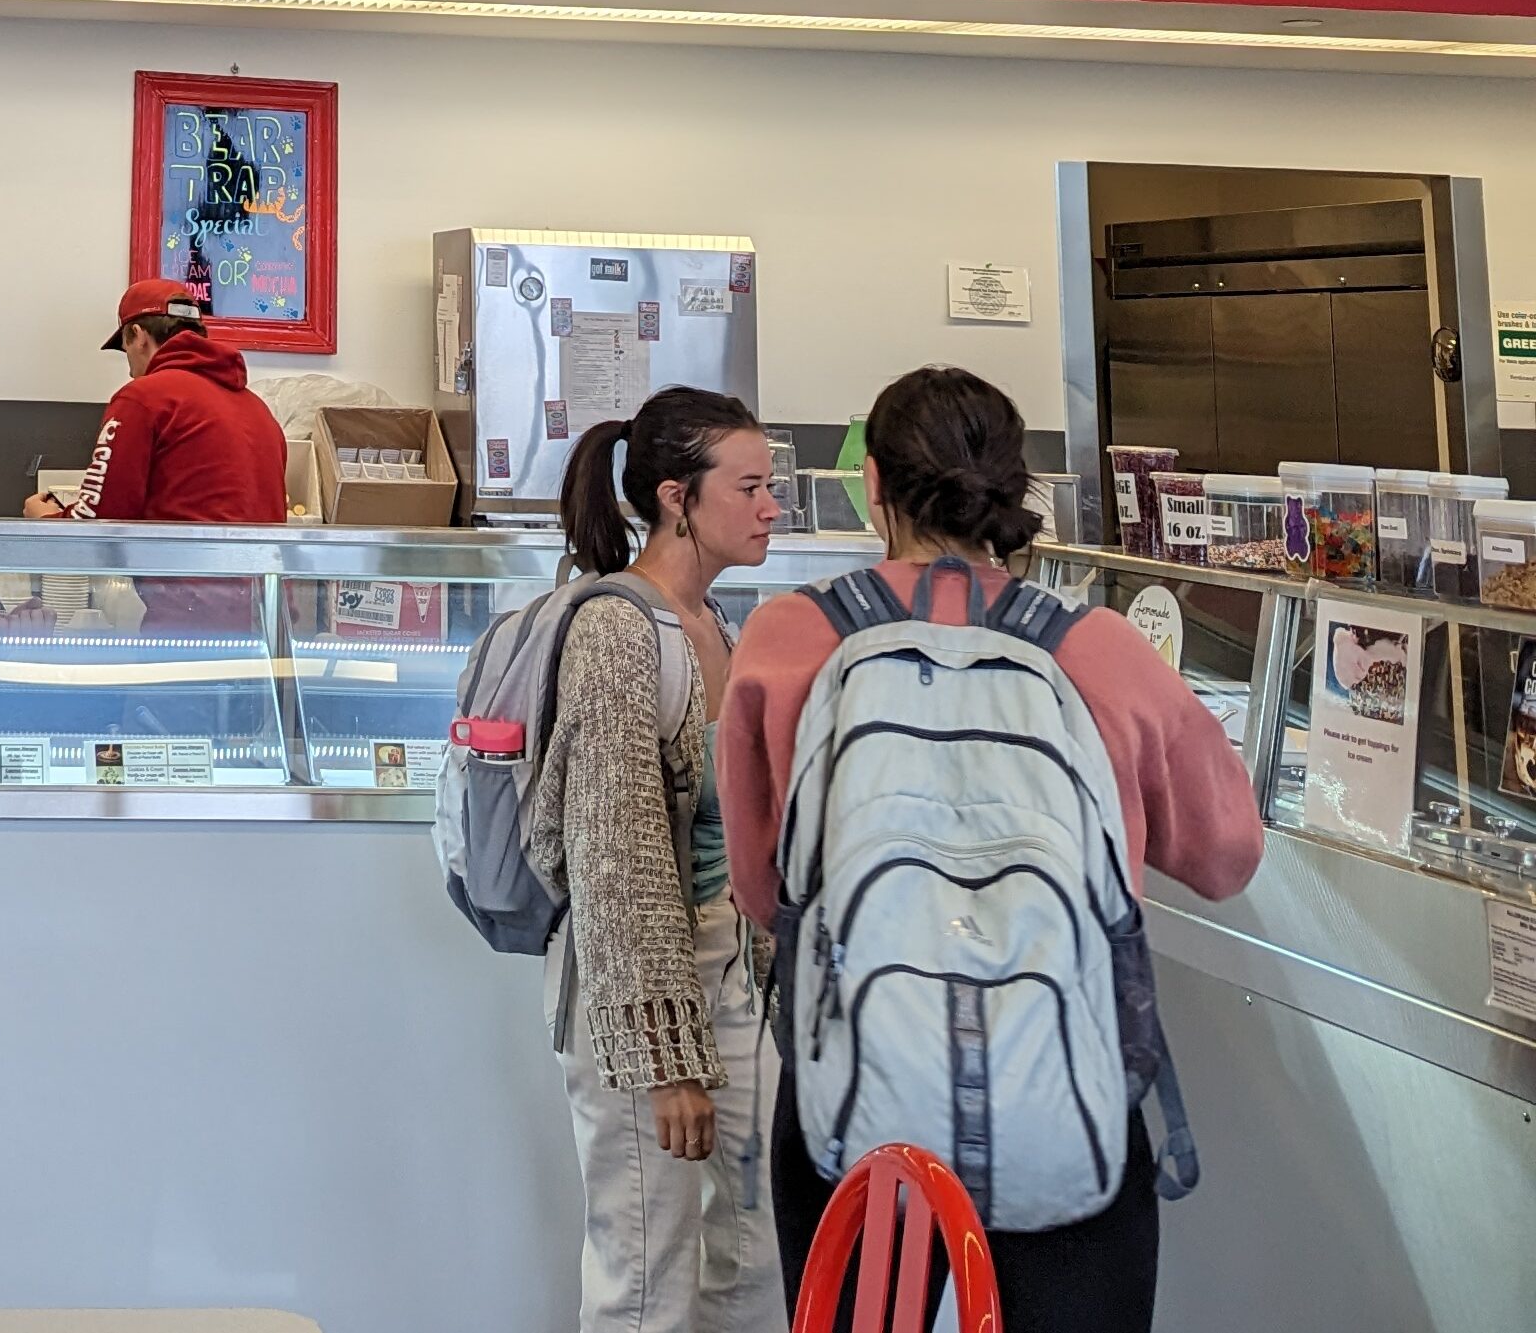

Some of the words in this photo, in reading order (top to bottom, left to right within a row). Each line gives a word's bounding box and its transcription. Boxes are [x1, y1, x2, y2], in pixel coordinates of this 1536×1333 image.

[175, 112, 281, 163] BEAR
[169, 163, 286, 204] TRAP
[181, 208, 268, 247] Special
[218, 260, 250, 286] OR
[591, 262, 603, 276] got
[605, 262, 626, 276] milk?
[1167, 497, 1204, 514] Small
[1167, 523, 1181, 537] 16
[1186, 526, 1205, 539] oz.
